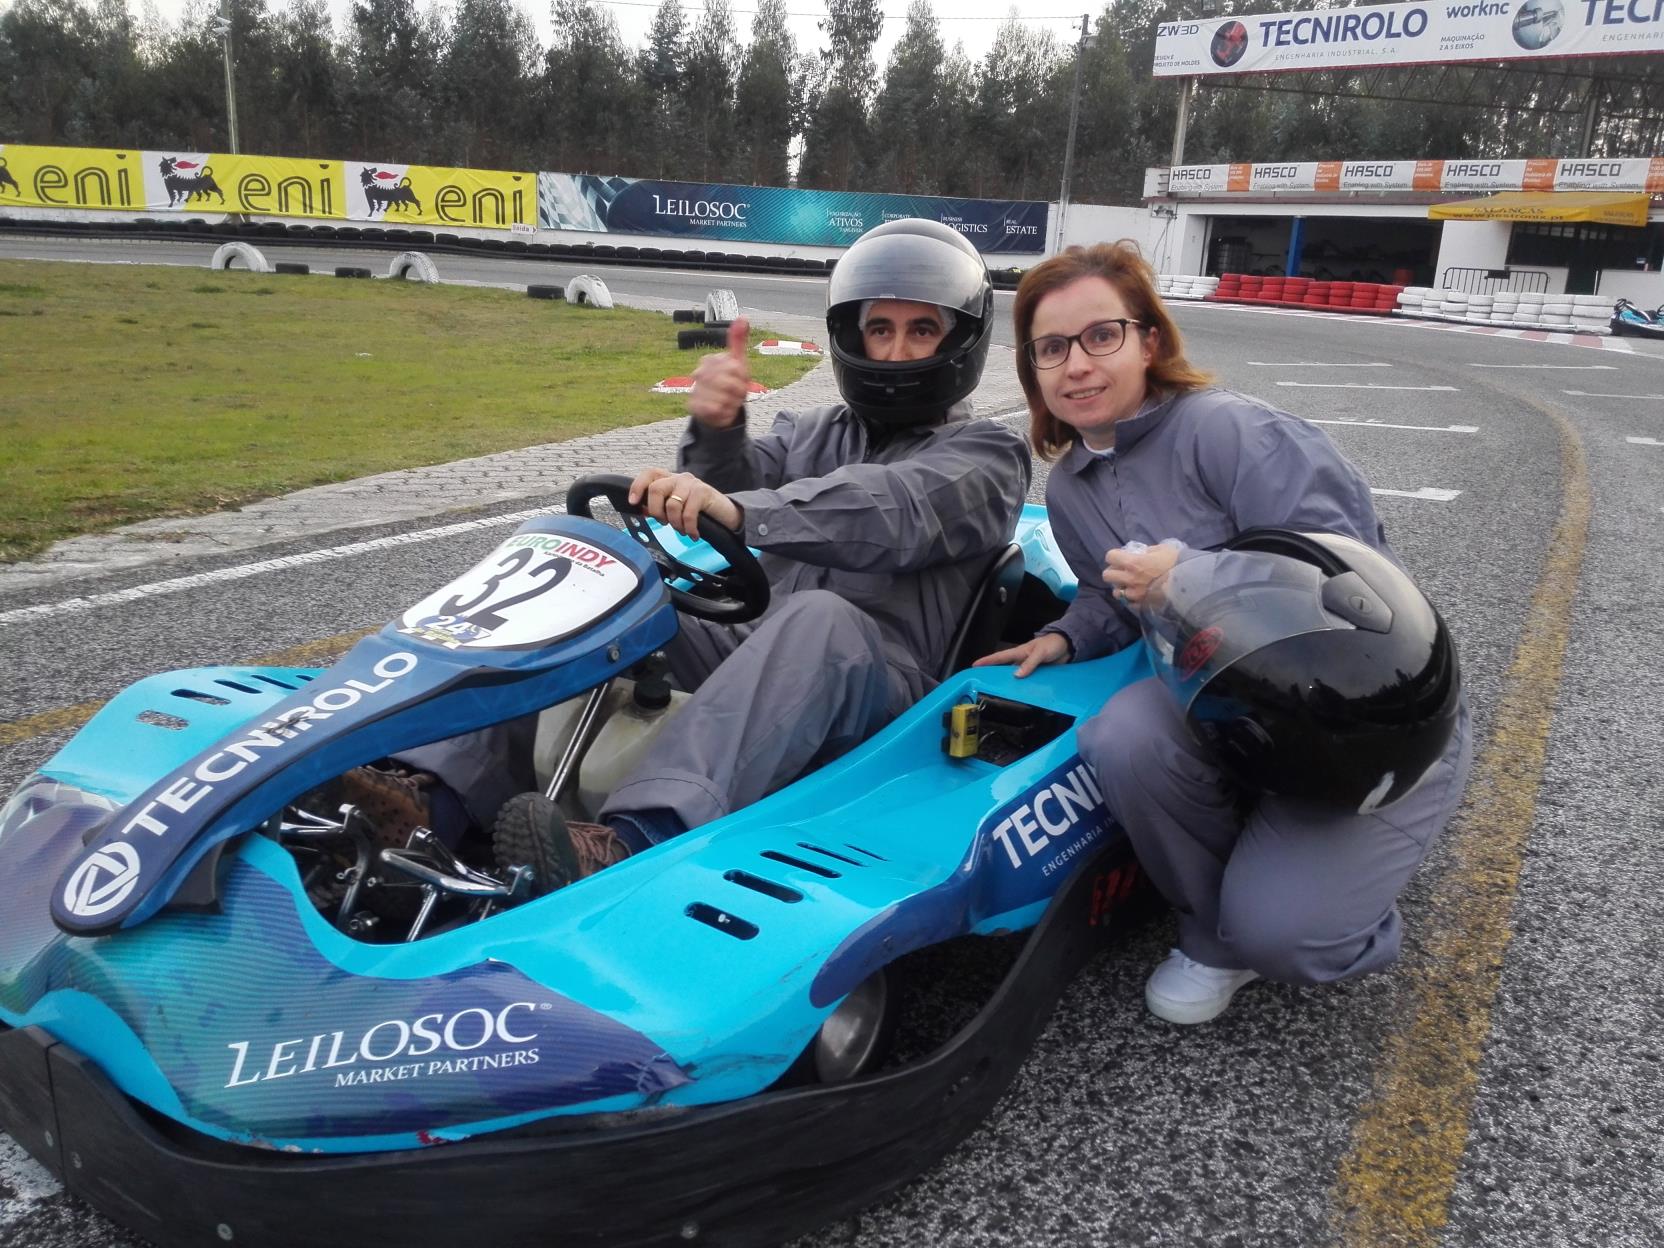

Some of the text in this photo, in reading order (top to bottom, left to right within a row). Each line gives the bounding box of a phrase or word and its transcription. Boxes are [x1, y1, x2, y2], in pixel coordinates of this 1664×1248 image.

[1446, 1, 1510, 19] worknc
[1259, 8, 1428, 47] TECNIROLO
[1275, 52, 1324, 61] ENGENHARIA
[33, 153, 132, 207] eni
[1172, 169, 1211, 181] HASCO
[1254, 166, 1298, 179] HASCO
[1344, 165, 1394, 177] HASCO
[1446, 164, 1502, 177] HASCO
[1560, 163, 1622, 177] HASCO
[238, 163, 333, 215] eni
[434, 175, 524, 225] eni
[652, 195, 747, 220] LEILOSOC
[828, 217, 863, 227] ATIVOS
[689, 218, 747, 228] MARKET PARTNERS
[1005, 225, 1038, 235] ESTATE
[505, 535, 616, 568] EUROINDY
[439, 547, 572, 631] 32
[121, 651, 419, 837] TECNIROLO
[991, 761, 1104, 870] TECNI
[1041, 825, 1103, 877] ENGENHARIA
[224, 1002, 539, 1089] LEILOSOC
[334, 1048, 540, 1088] MARKET PARTNERS
